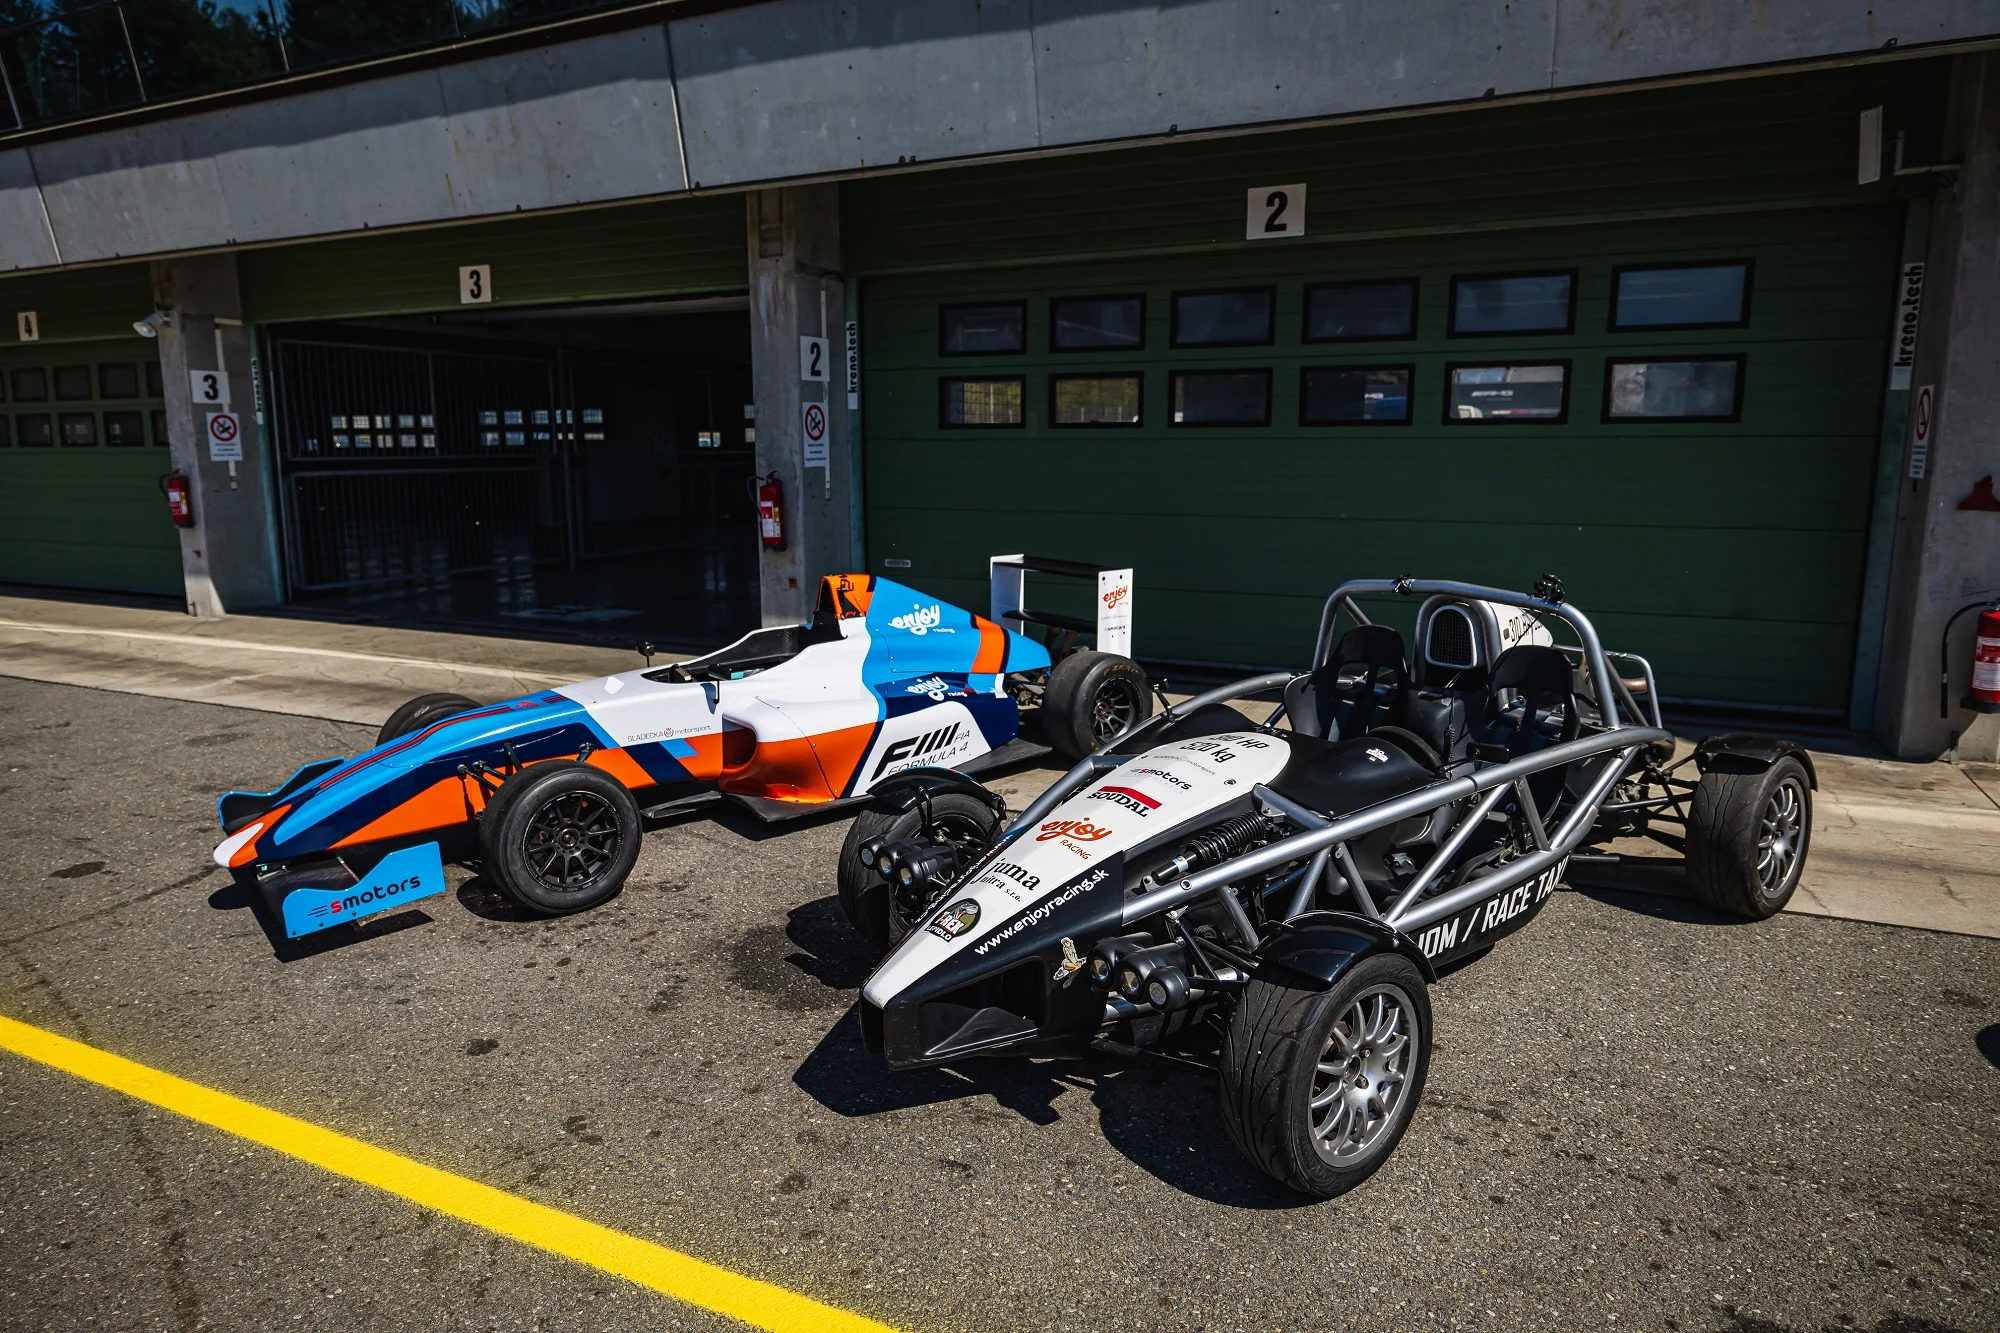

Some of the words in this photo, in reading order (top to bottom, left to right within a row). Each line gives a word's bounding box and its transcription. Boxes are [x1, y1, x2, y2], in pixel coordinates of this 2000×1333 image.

[1264, 190, 1288, 234] 2
[470, 269, 481, 299] 3
[24, 315, 32, 337] 4
[1895, 264, 1924, 367] kreno.tech
[810, 341, 821, 377] 2
[847, 322, 857, 394] kreno.tech
[203, 374, 218, 400] 3
[1102, 585, 1128, 609] enjoy
[888, 604, 940, 635] enjoy
[905, 676, 949, 701] enjoy
[628, 731, 664, 742] SLADECKA
[675, 725, 712, 737] motorsport
[954, 730, 970, 743] FIA
[1236, 739, 1270, 749] HP
[960, 742, 969, 752] 4
[1211, 747, 1237, 763] kg
[1139, 768, 1192, 790] smotors
[1087, 792, 1150, 817] SOUDAL
[1036, 817, 1112, 842] enjoy
[1060, 839, 1092, 860] RACING
[970, 858, 1041, 891] juma
[330, 875, 421, 914] smotors
[1004, 886, 1021, 902] s.r.o.
[1481, 880, 1535, 933] RACE
[974, 869, 1109, 956] www.enjoyracing.sk
